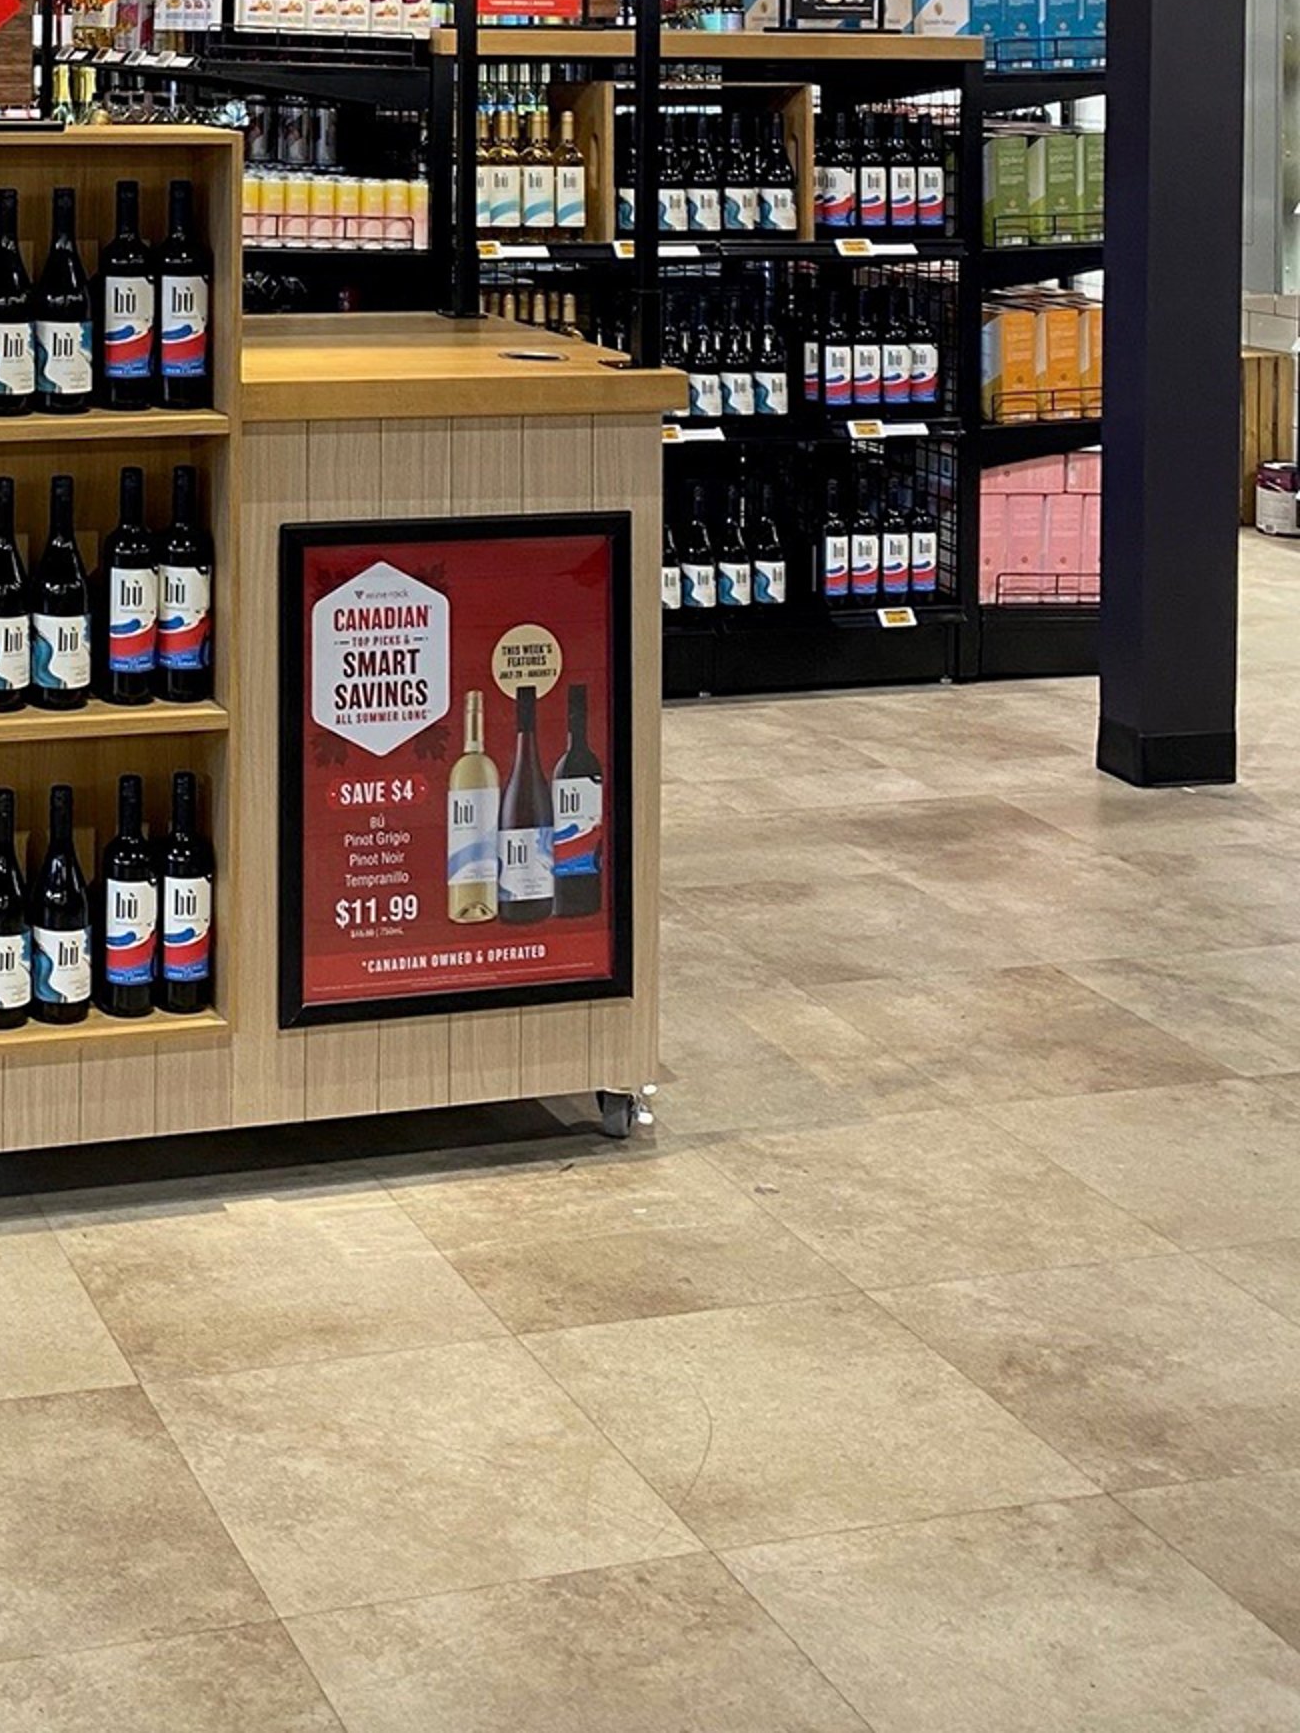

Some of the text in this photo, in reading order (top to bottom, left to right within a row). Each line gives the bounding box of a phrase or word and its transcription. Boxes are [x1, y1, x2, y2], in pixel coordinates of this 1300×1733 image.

[114, 286, 137, 314] bù
[171, 286, 194, 313] bù
[3, 332, 24, 358] bù
[53, 331, 74, 357] bù
[120, 579, 143, 607] bù
[164, 576, 186, 605] bù
[4, 627, 23, 652] bù
[58, 626, 79, 652] bù
[352, 636, 370, 647] TOP
[373, 635, 400, 646] PICKS
[343, 648, 420, 678] SMART
[335, 679, 428, 710] SAVINGS
[336, 714, 353, 725] ALL
[356, 711, 398, 724] SUMMER
[340, 779, 413, 805] SAVE $4
[344, 831, 411, 847] Pinot Grigio
[350, 851, 405, 867] Pinot Noir
[345, 871, 409, 888] Tempranillo
[115, 891, 138, 920] bù
[174, 888, 197, 916] bù
[335, 894, 418, 929] $11.99
[58, 941, 79, 968] bù
[431, 952, 472, 968] OWNED
[476, 950, 483, 965] &
[488, 944, 546, 963] OPERATED
